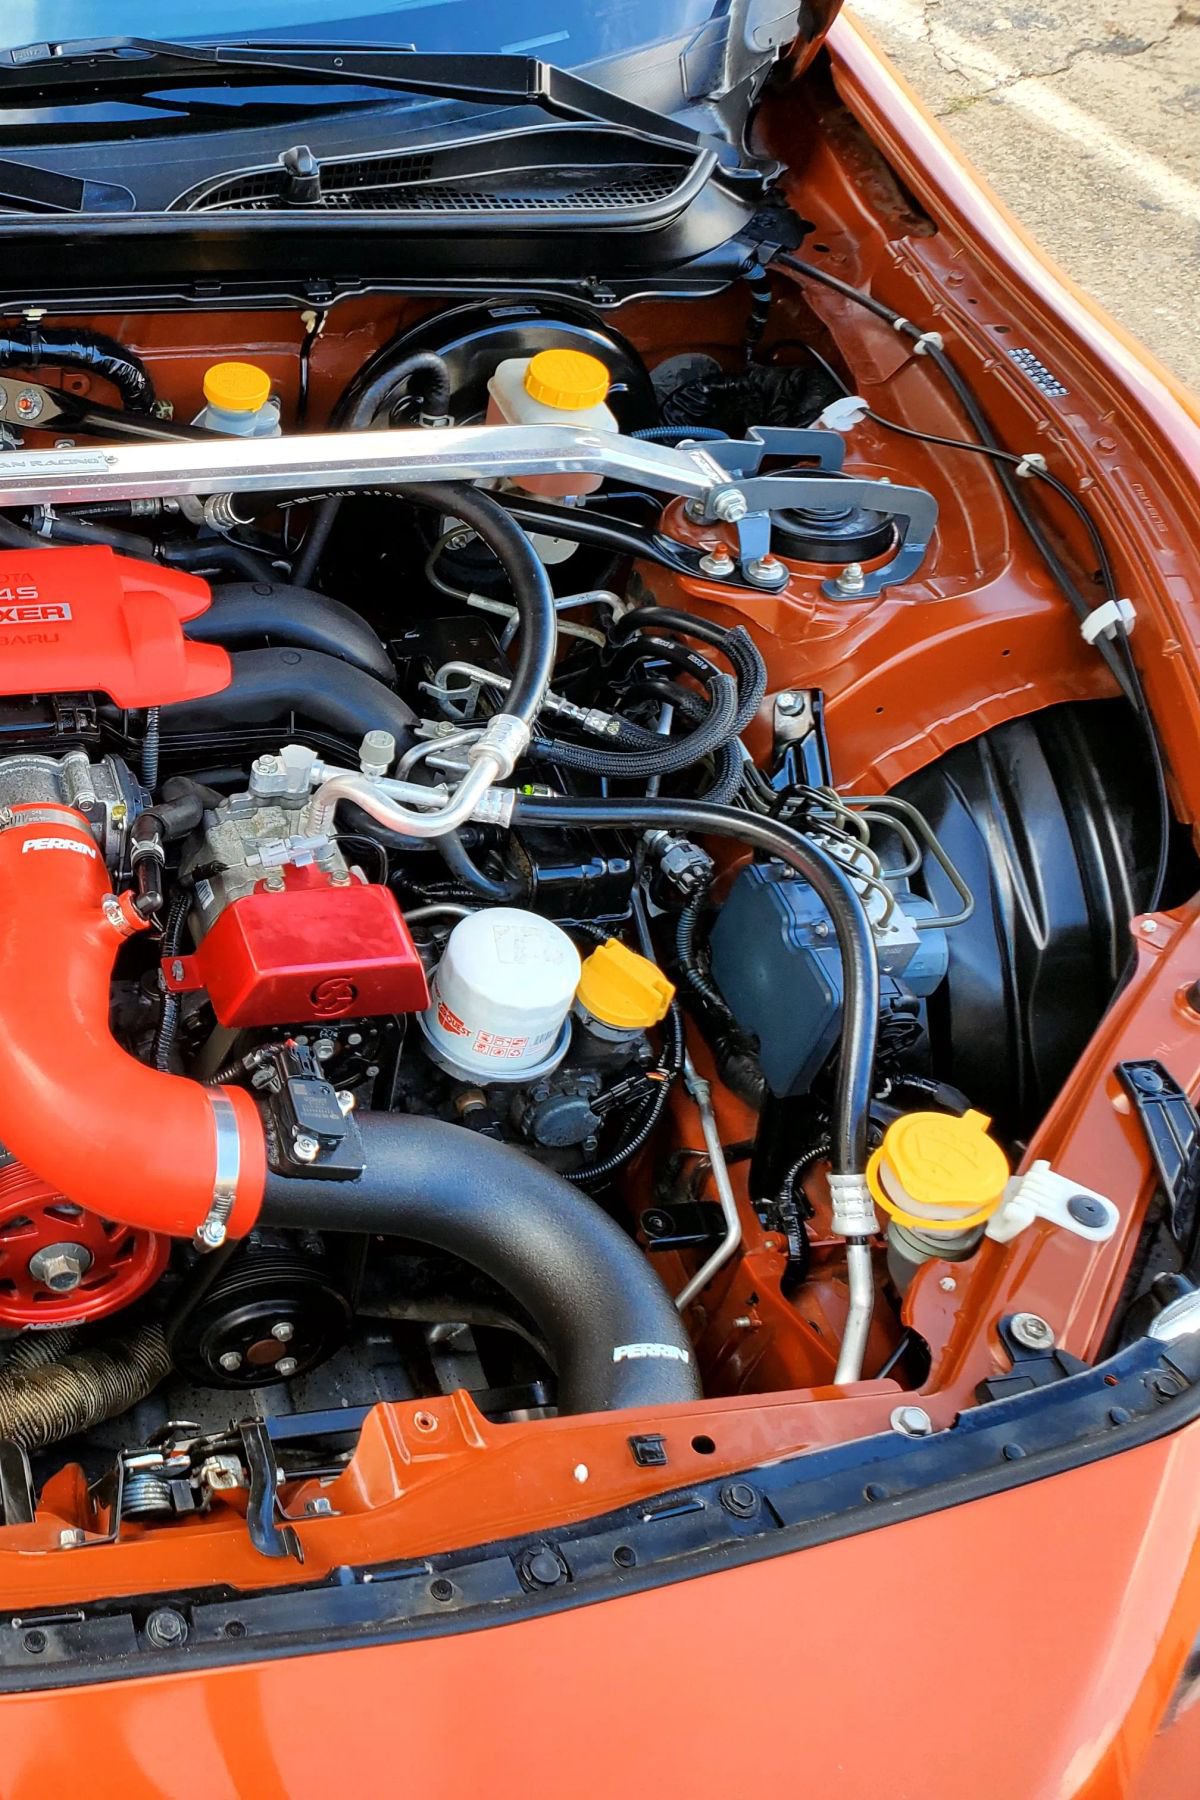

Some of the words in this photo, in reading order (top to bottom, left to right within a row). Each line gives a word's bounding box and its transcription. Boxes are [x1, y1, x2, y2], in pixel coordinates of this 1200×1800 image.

[29, 456, 101, 467] RACING
[22, 837, 96, 859] PERRIN
[613, 1342, 689, 1364] PERRIN
